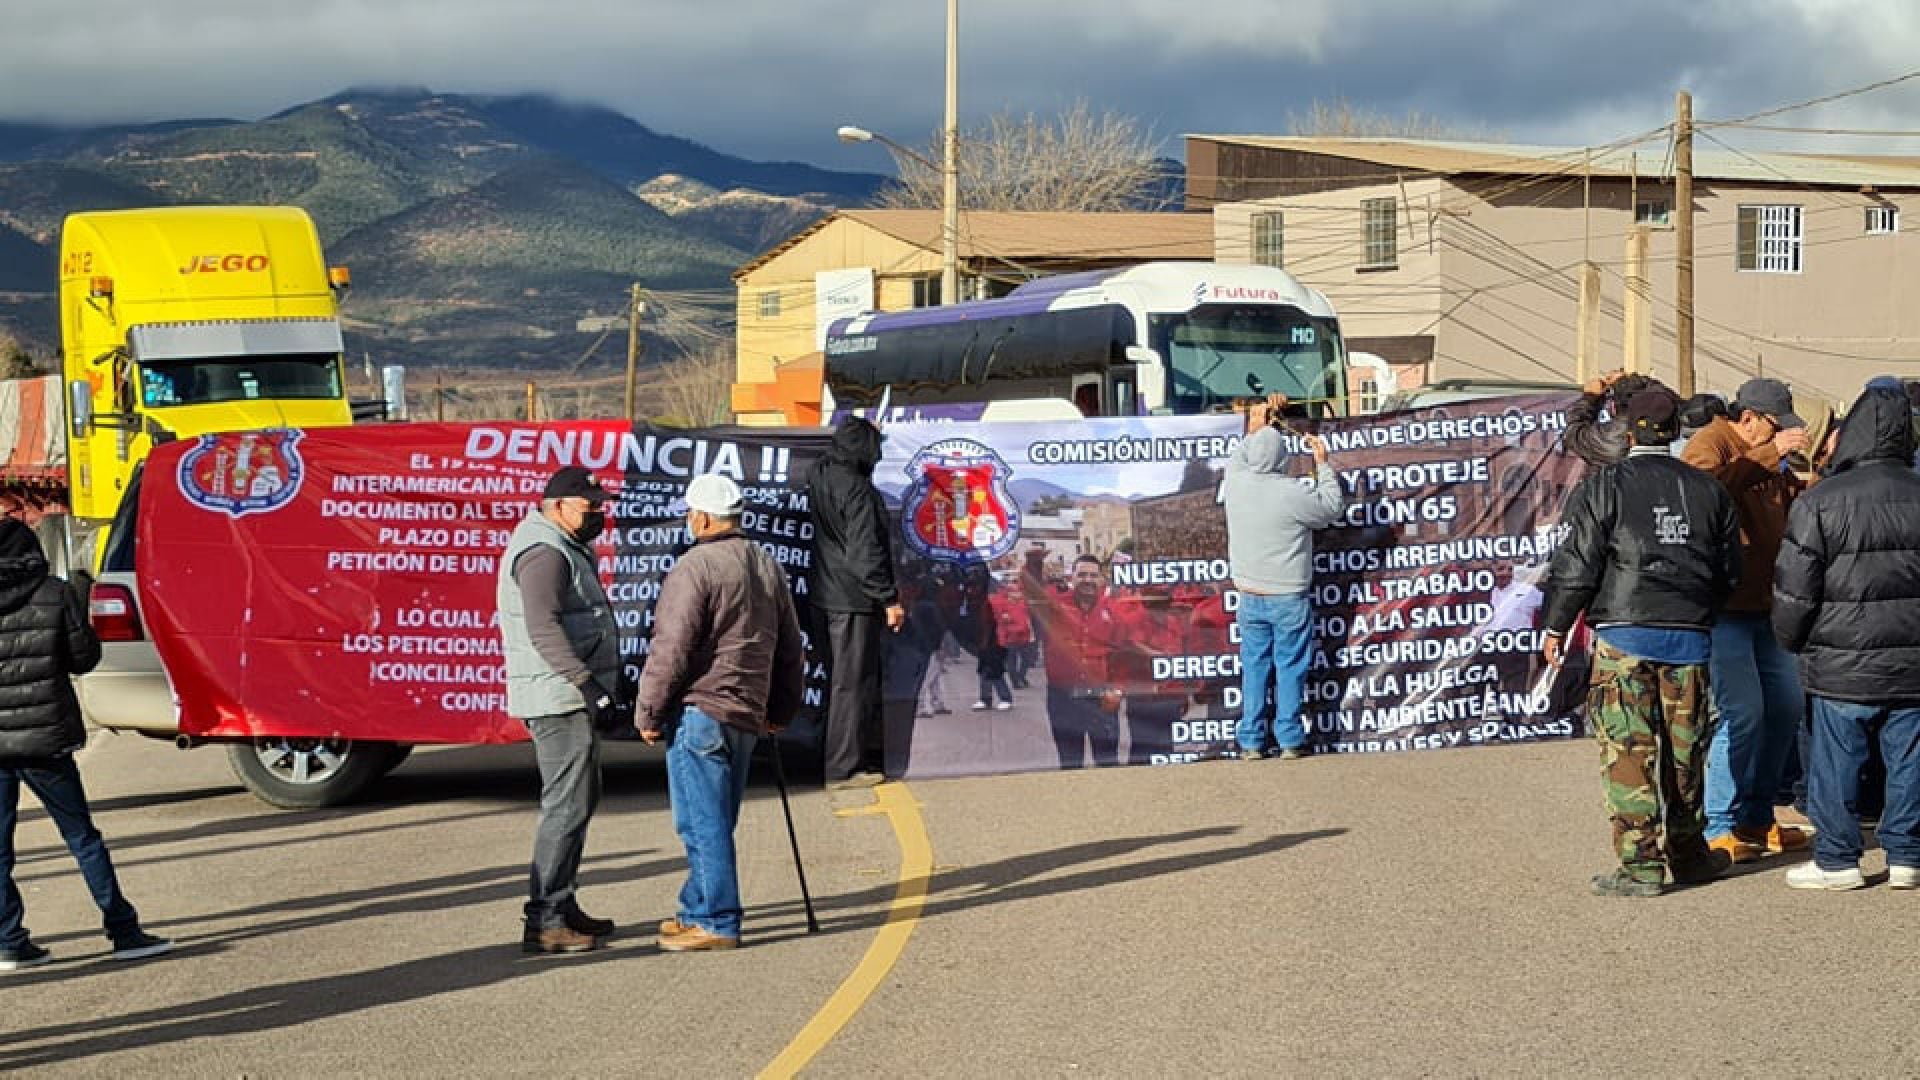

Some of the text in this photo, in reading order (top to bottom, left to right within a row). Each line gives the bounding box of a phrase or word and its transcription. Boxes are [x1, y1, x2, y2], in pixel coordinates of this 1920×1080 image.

[178, 254, 269, 275] JEGO
[1212, 286, 1279, 300] Futura
[1030, 435, 1150, 464] COMISIÓN
[1373, 427, 1406, 446] DE
[1410, 412, 1537, 442] DERECHOS
[410, 454, 433, 470] EL
[465, 427, 745, 480] DENUNCIA
[332, 475, 515, 495] INTERAMERICANA
[1341, 470, 1361, 493] Y
[1367, 457, 1489, 491] PROTEJE
[321, 499, 457, 520] DOCUMENTO
[463, 502, 487, 520] AL
[741, 511, 769, 533] DE
[1334, 495, 1457, 527] CIÓN 65
[379, 527, 448, 545] PLAZO
[453, 530, 483, 547] DE
[328, 550, 494, 574] PETICIÓN DE UN
[1113, 559, 1229, 586] NUESTRO
[1347, 581, 1378, 604] AL
[1381, 569, 1494, 602] TRABAJO
[397, 608, 425, 627] LO
[430, 609, 485, 629] CUAL
[1351, 614, 1369, 636] A
[1375, 608, 1405, 633] LA
[1410, 602, 1494, 630] SALUD
[343, 634, 385, 653] LOS
[1335, 637, 1477, 668] SEGURIDAD
[1345, 676, 1363, 700] A
[1369, 675, 1400, 698] LA
[1405, 665, 1499, 696] HUELGA
[1317, 710, 1353, 733] UN
[1359, 694, 1482, 734] AMBIENTE
